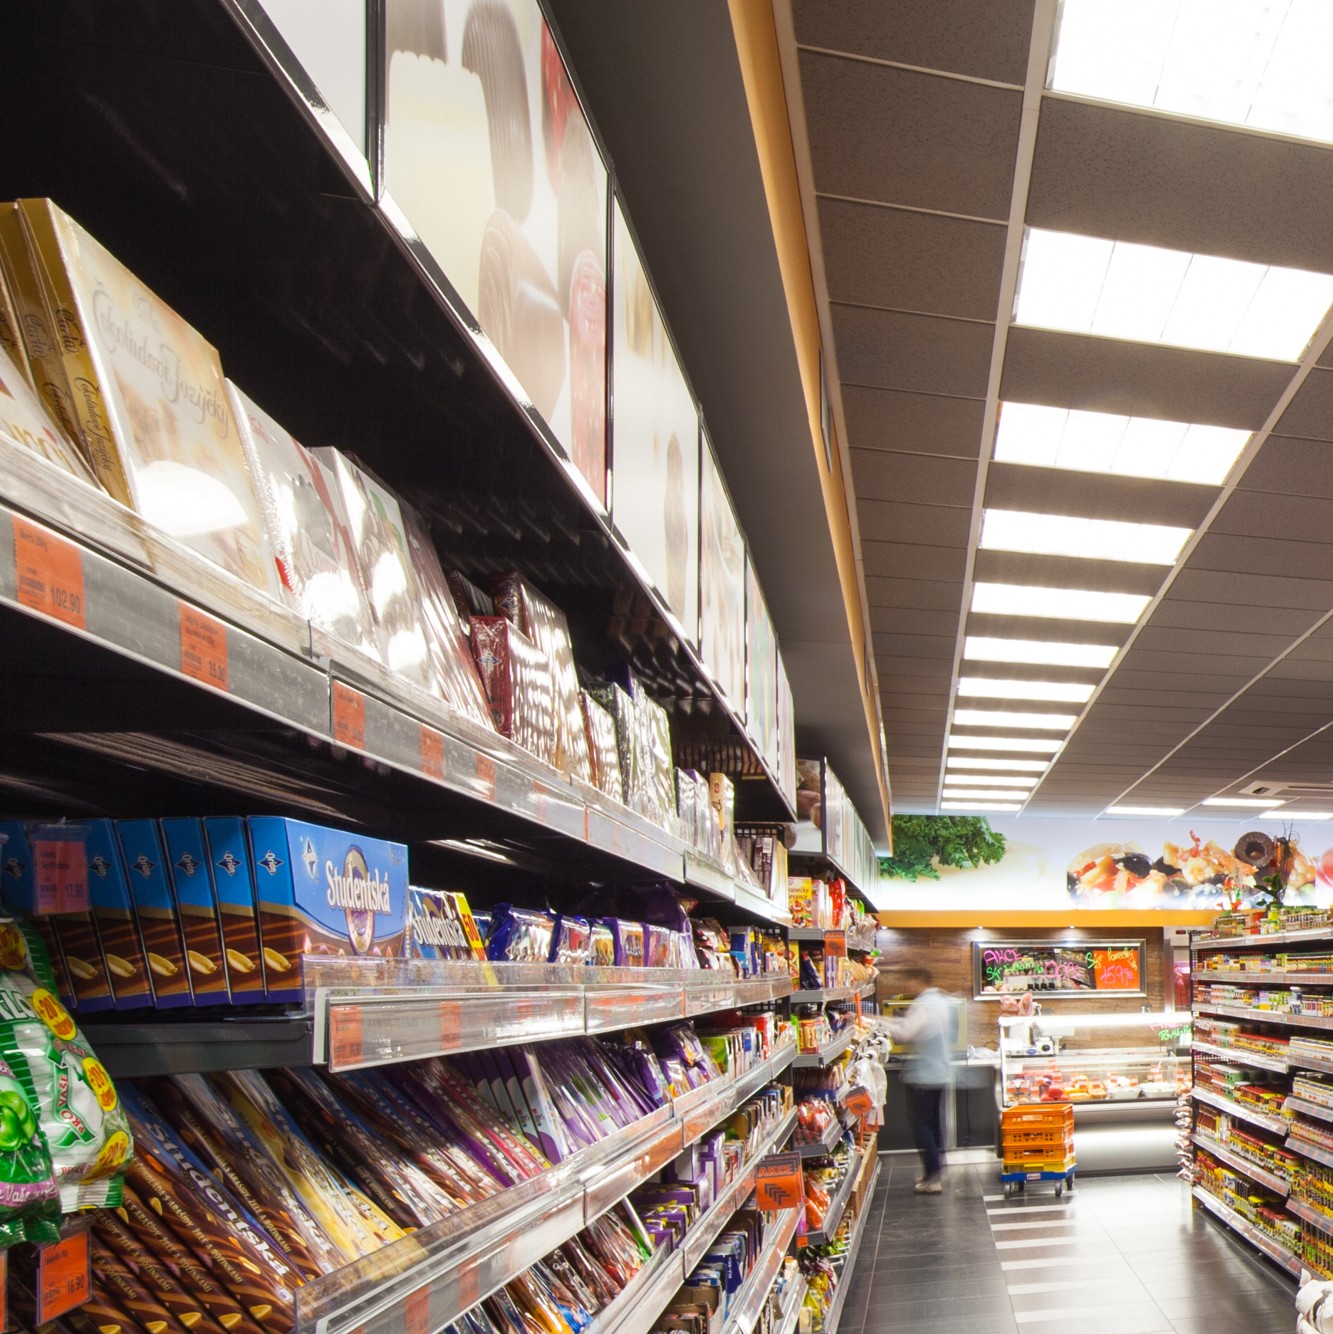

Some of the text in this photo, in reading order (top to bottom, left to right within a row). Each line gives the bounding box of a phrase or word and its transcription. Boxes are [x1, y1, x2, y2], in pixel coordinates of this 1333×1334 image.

[50, 585, 80, 614] 102.90
[325, 859, 391, 913] Studentská
[759, 1164, 795, 1176] AKCE
